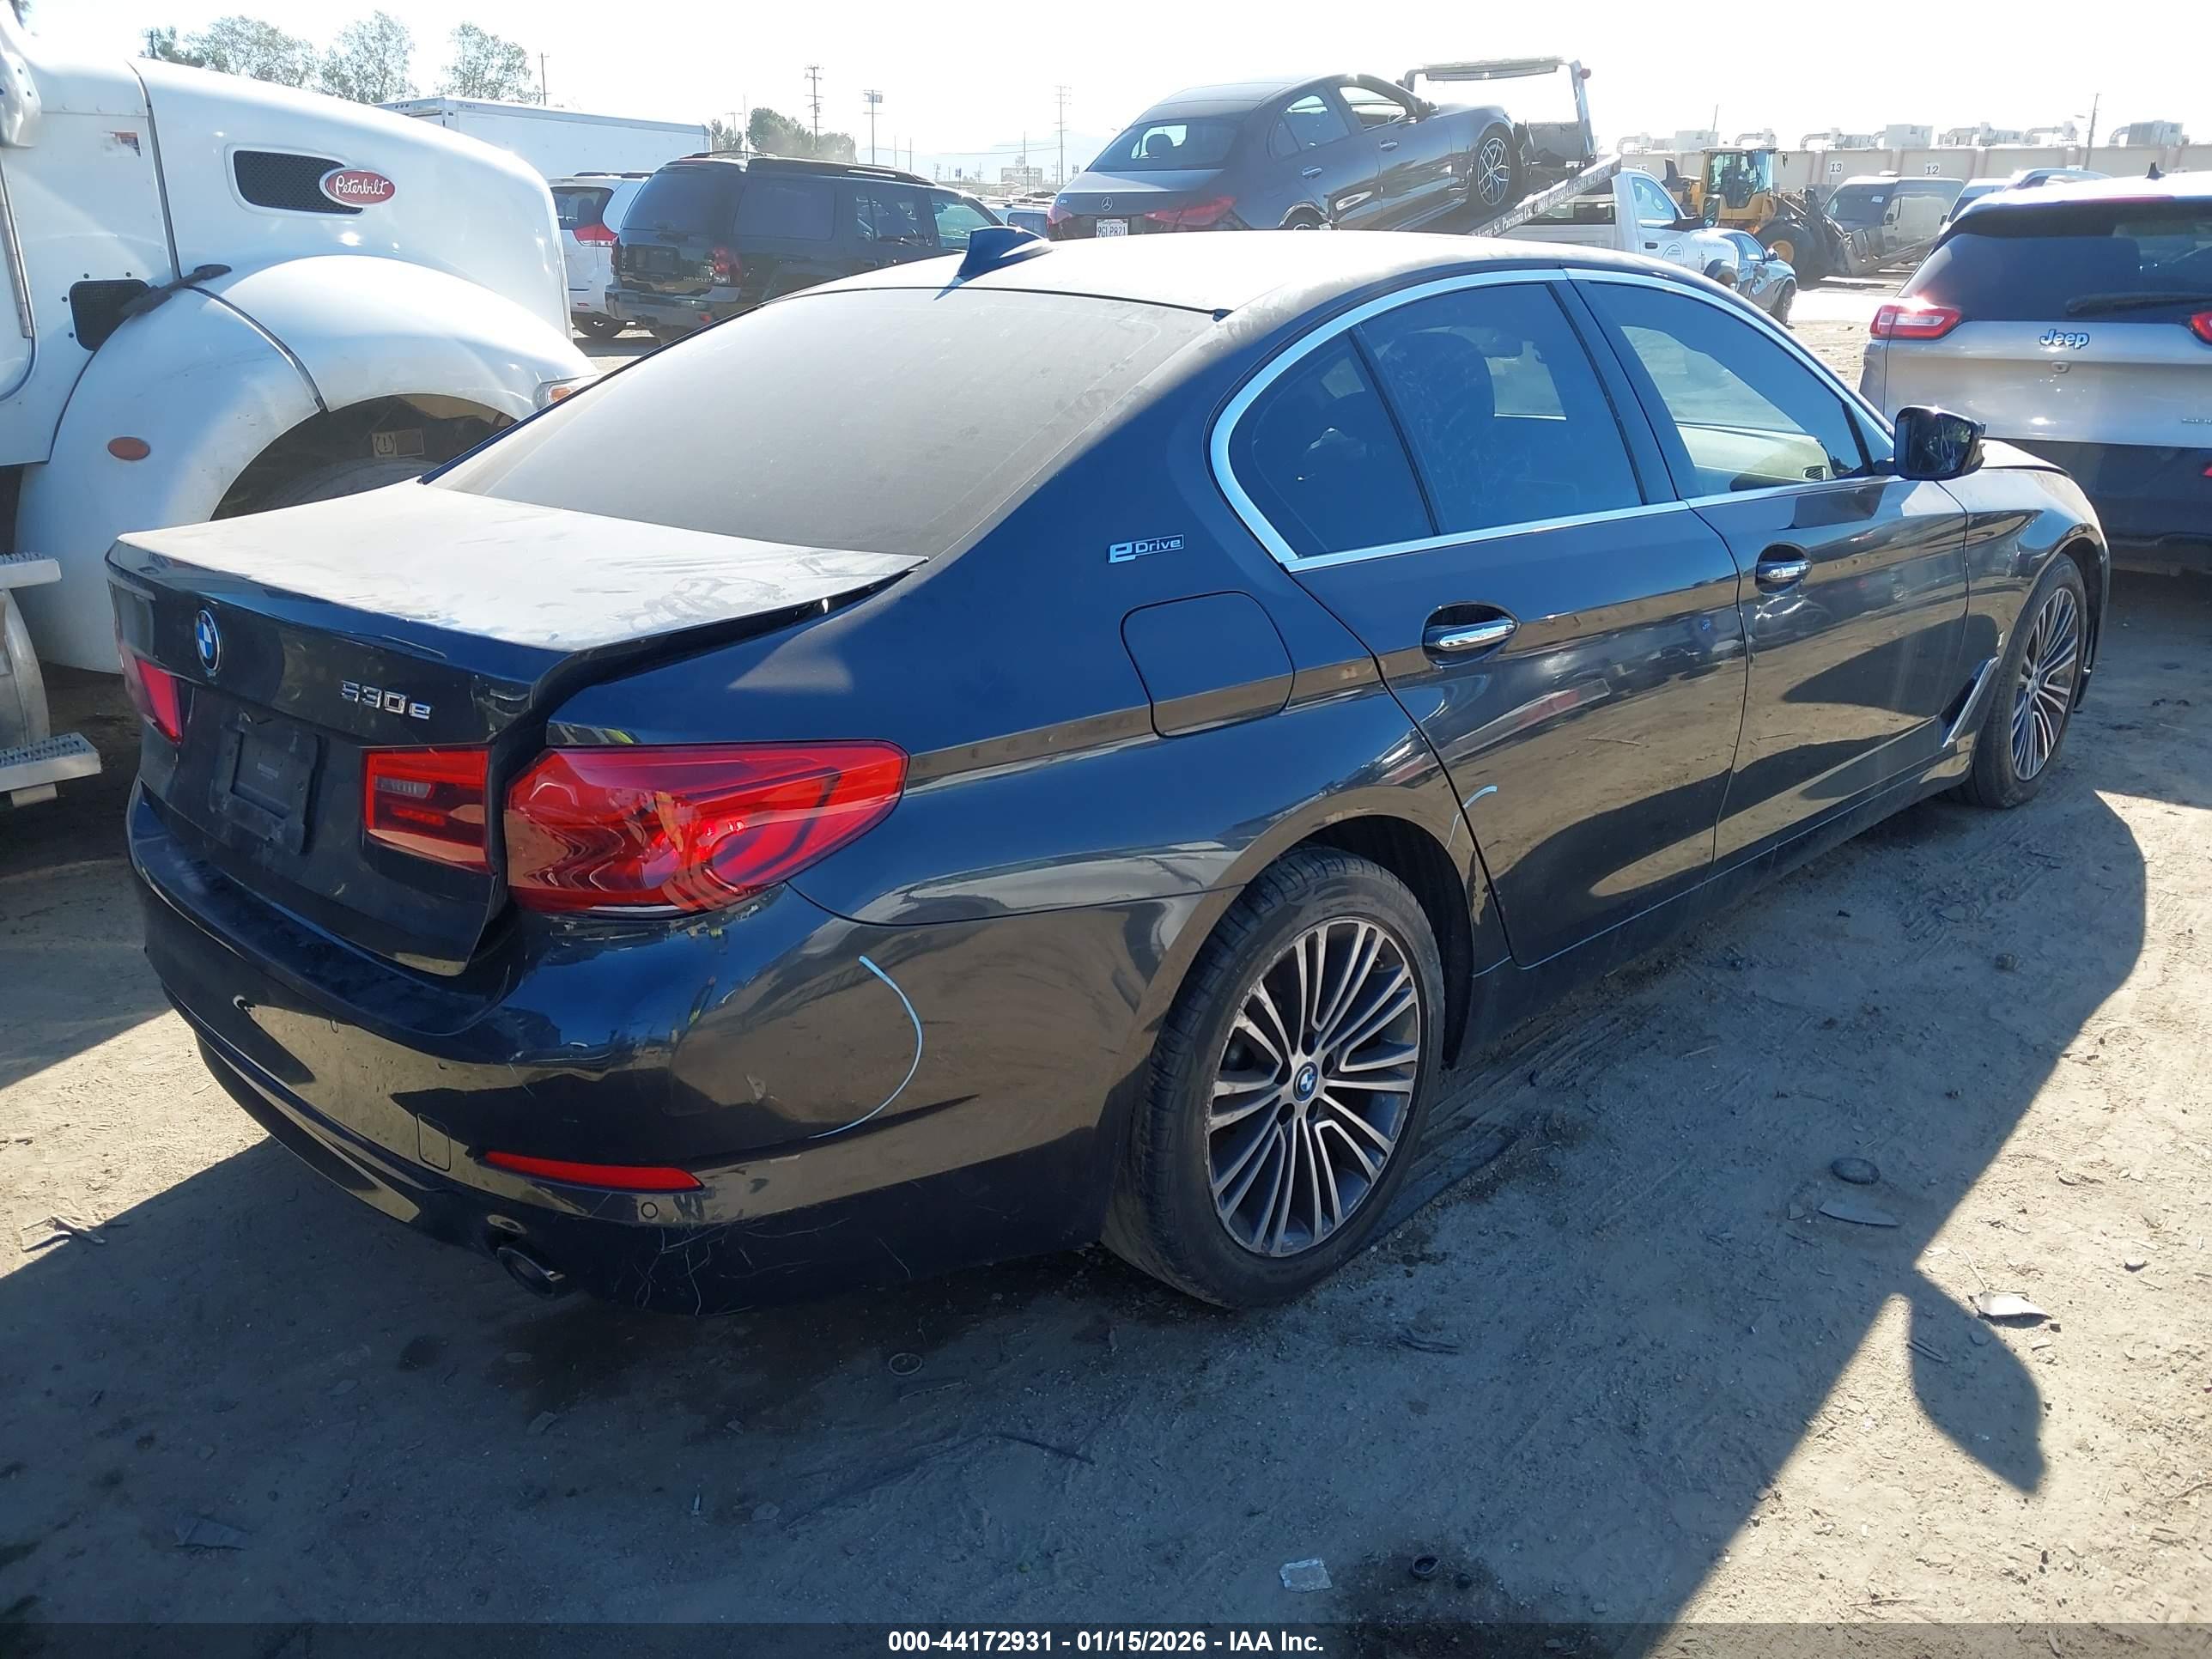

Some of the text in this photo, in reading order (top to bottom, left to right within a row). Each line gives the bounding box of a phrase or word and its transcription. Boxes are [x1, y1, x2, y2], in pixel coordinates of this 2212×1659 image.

[1830, 163, 1843, 173] 13
[1925, 165, 1939, 175] 12
[335, 174, 389, 195] Peterbilt
[2039, 329, 2090, 349] Jeep
[341, 680, 431, 720] 530e
